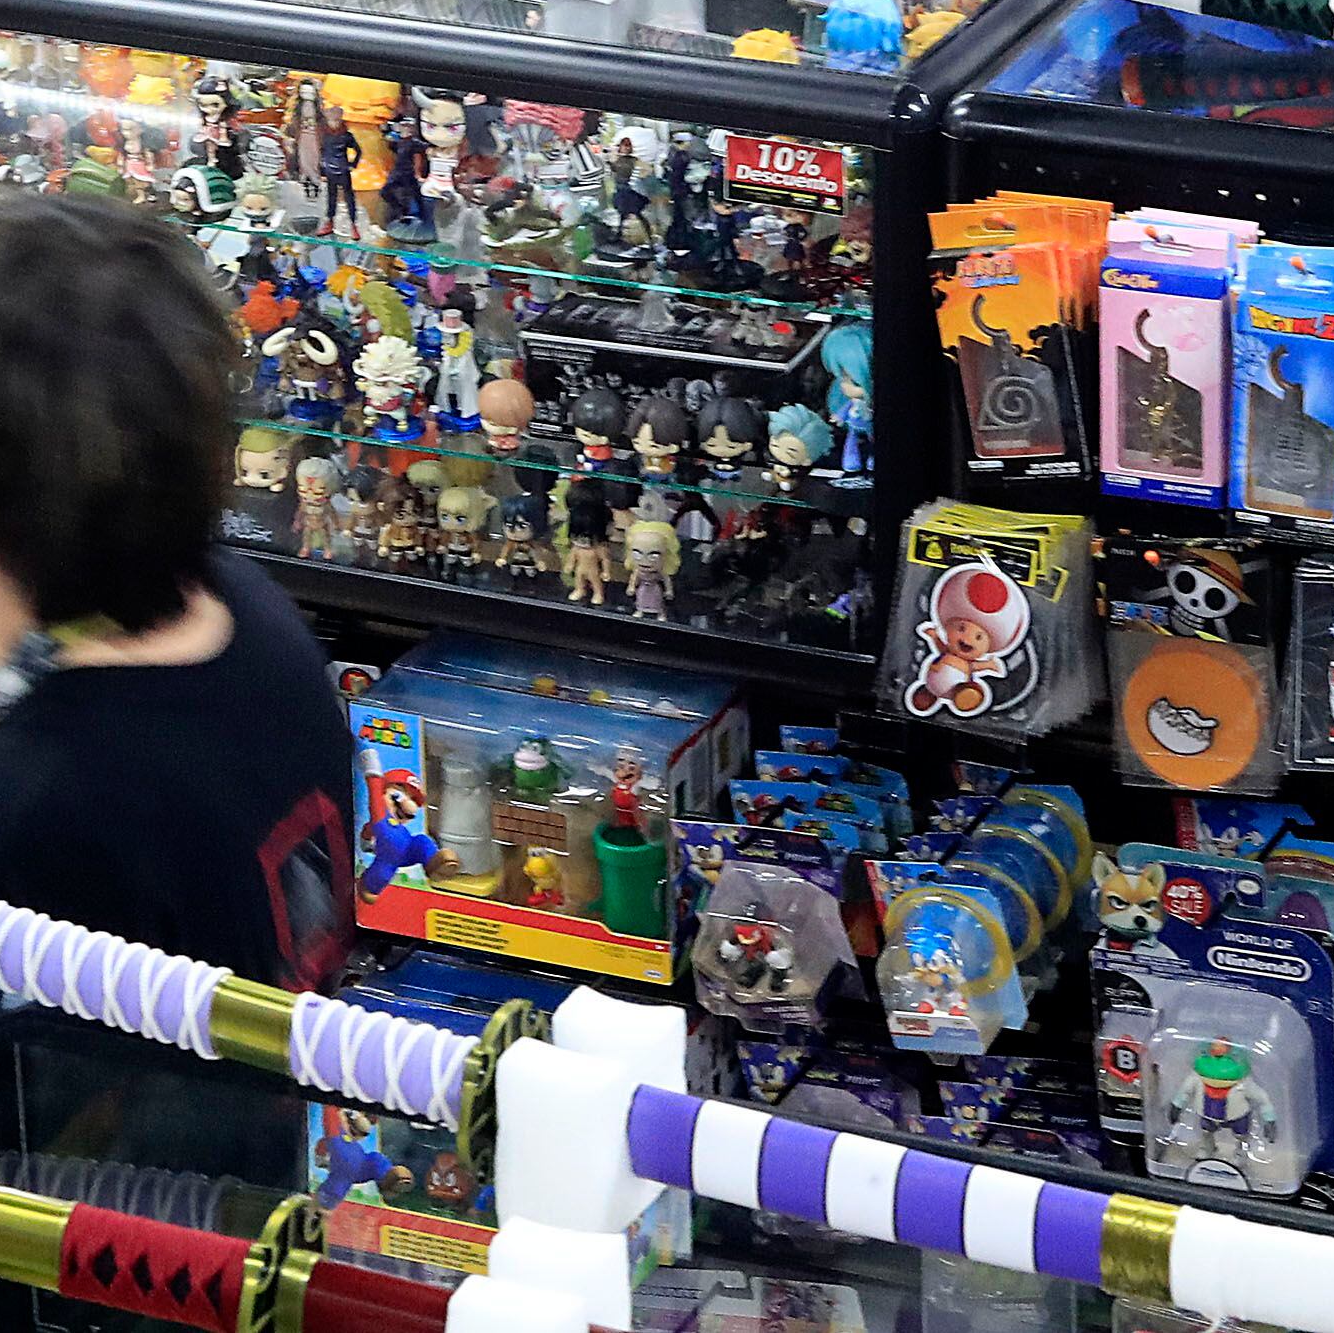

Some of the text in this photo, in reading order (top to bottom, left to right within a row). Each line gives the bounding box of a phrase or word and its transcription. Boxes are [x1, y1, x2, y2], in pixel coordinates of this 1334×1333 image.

[754, 142, 823, 177] 10%
[734, 163, 839, 194] Descuento
[358, 726, 414, 749] MARIO
[1166, 883, 1205, 902] 40%
[1169, 896, 1205, 917] SALE
[1223, 929, 1295, 950] WORLD OF
[1214, 950, 1305, 978] Nintendo
[1116, 1048, 1138, 1070] B
